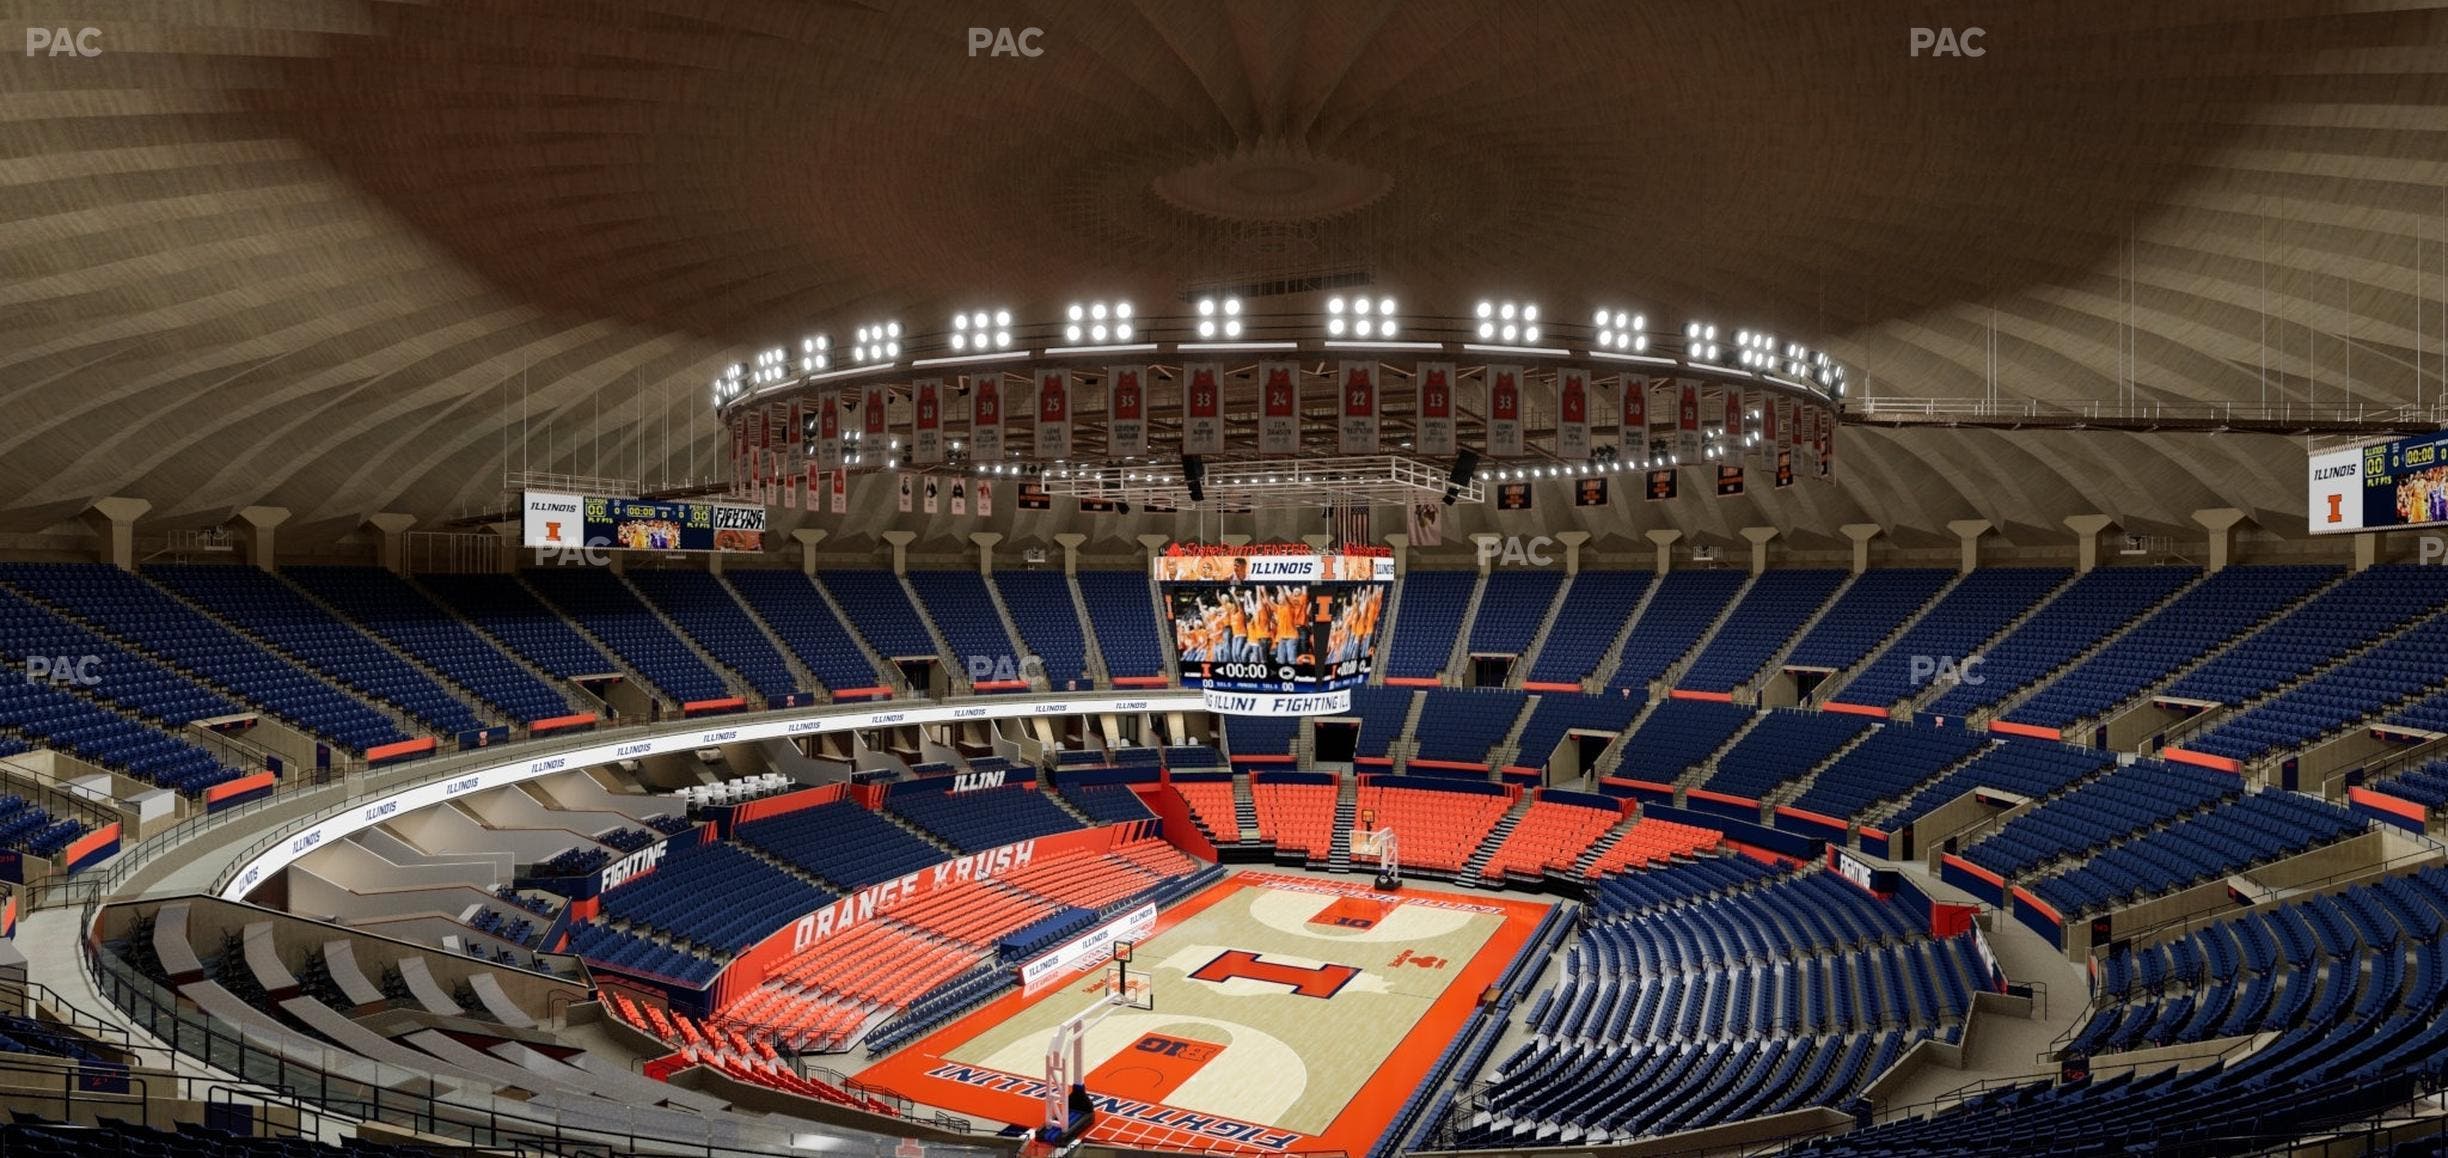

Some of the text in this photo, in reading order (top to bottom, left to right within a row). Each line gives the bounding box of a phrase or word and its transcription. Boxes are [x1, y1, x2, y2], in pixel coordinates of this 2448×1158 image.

[1120, 395, 1136, 408] 35
[1196, 393, 1211, 406] 33
[1271, 392, 1288, 406] 24
[1351, 391, 1367, 406] 22
[1429, 393, 1444, 407] 13
[2406, 446, 2434, 465] 00:00
[2314, 463, 2357, 481] ILLINOIS
[2367, 457, 2384, 475] 00
[530, 502, 577, 513] ILLINOIS
[587, 505, 604, 515] 00
[629, 507, 654, 517] 00:00
[717, 507, 763, 520] FIGHTING
[694, 511, 709, 521] 00
[715, 516, 765, 529] ILLINI
[1251, 562, 1313, 575] ILLINOIS
[1226, 662, 1268, 679] 00:00
[1034, 704, 1067, 712] ILLINOIS
[1116, 701, 1148, 710] ILLINOIS
[1214, 694, 1257, 712] ILLINI
[1272, 696, 1338, 712] FIGHTING
[871, 713, 904, 724] ILLINOIS
[954, 708, 986, 717] ILLINOIS
[788, 721, 821, 732] ILLINOIS
[703, 730, 737, 743] ILLINOIS
[617, 743, 651, 757] ILLINOIS
[531, 758, 565, 774] ILLINOIS
[446, 777, 478, 795] ILLINOIS
[953, 769, 1007, 793] ILLINI
[365, 801, 397, 822] ILLINOIS
[292, 829, 321, 855] ILLINOIS
[600, 839, 668, 894] FIGHTING
[794, 841, 1036, 953] ORANGE KRUSH
[1028, 954, 1060, 977] ILLINOIS
